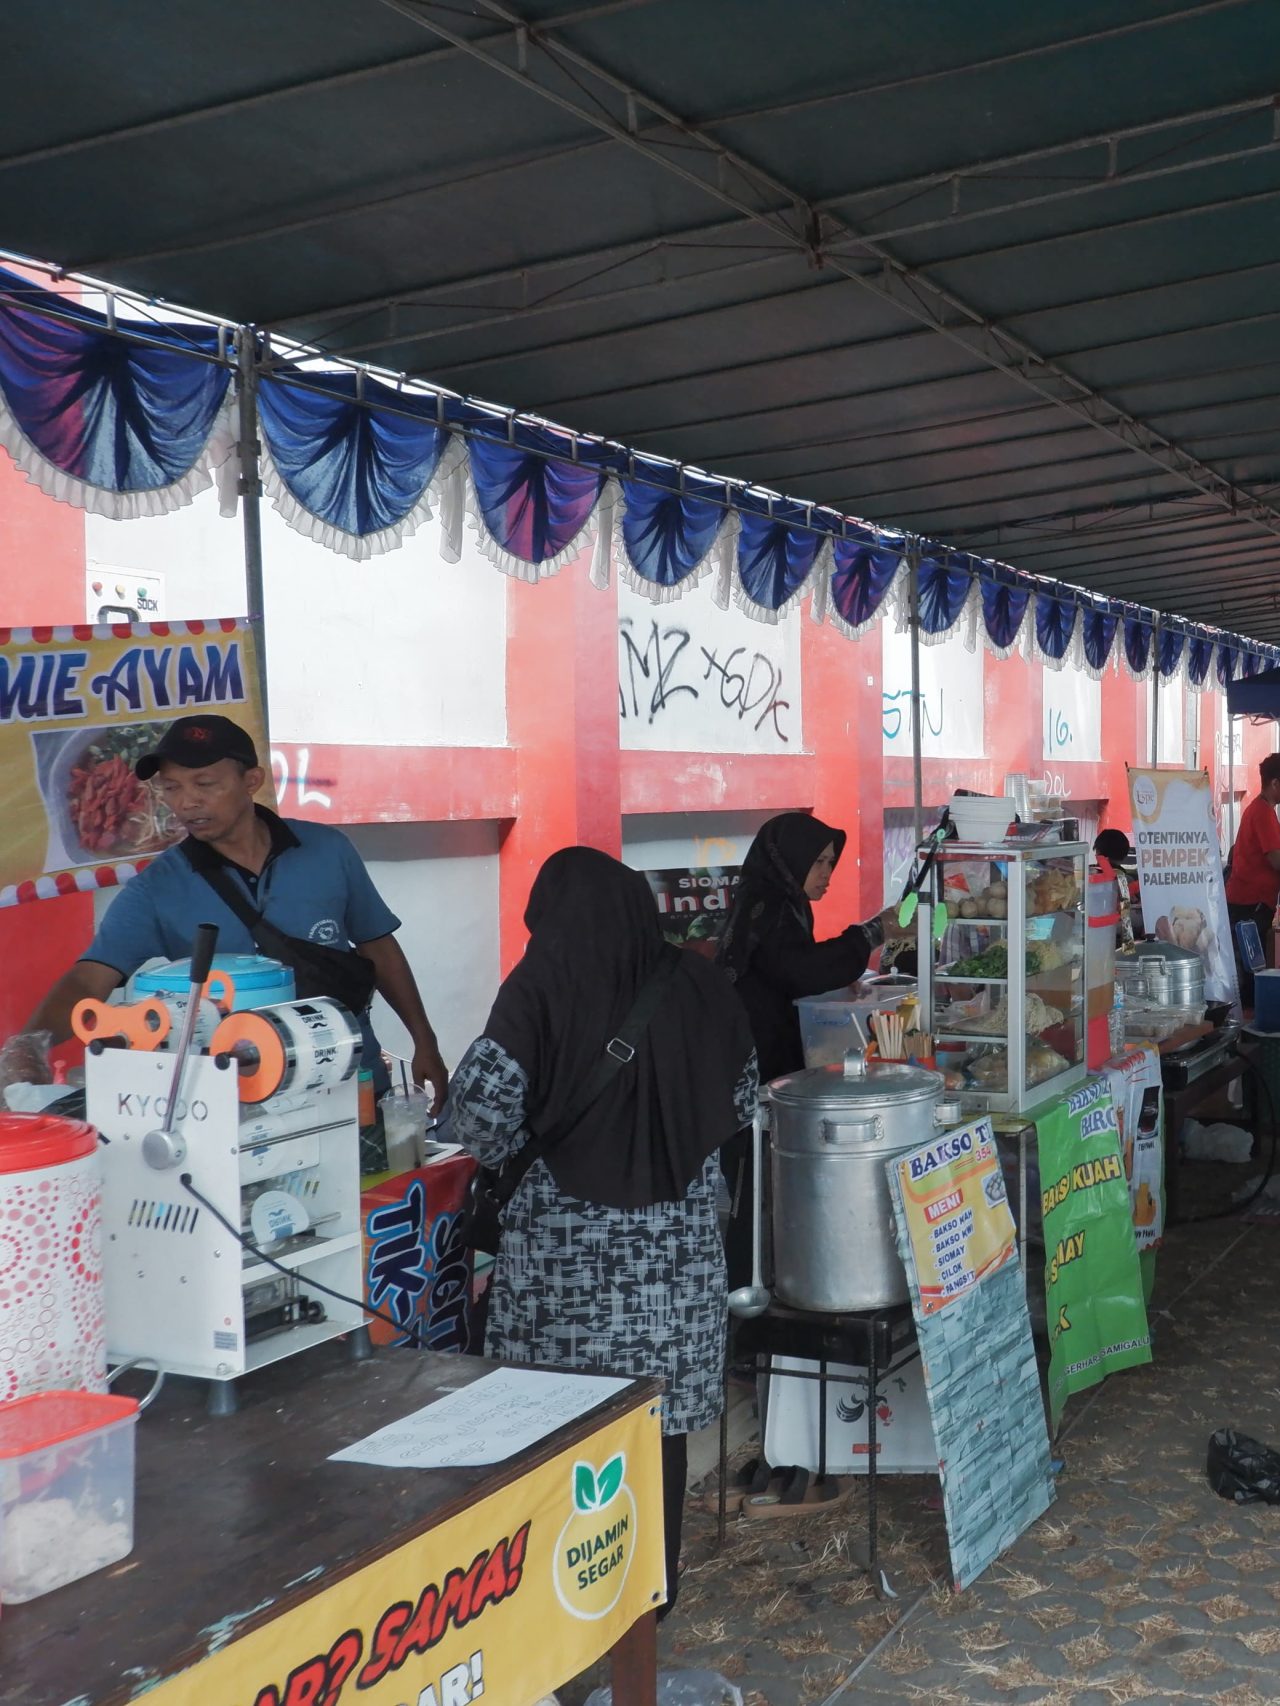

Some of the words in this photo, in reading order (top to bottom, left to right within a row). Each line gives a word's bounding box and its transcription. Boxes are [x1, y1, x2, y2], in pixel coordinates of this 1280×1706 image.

[91, 643, 245, 713] AYAM
[1138, 831, 1210, 845] OTENTIKNYA
[1141, 848, 1210, 868] PEMPEK
[657, 888, 735, 914] Ind
[314, 1047, 338, 1058] DRINK
[911, 1132, 972, 1180] BAKSO
[1072, 1154, 1122, 1192] KUAH
[933, 1218, 958, 1239] BAKSO
[935, 1233, 961, 1253] BAKSO
[937, 1245, 966, 1267] SIOMAY
[941, 1262, 963, 1281] CILOK
[566, 1514, 629, 1569] DIJAMIN
[577, 1546, 624, 1590] SEGAR
[356, 1519, 533, 1690] SAMA!
